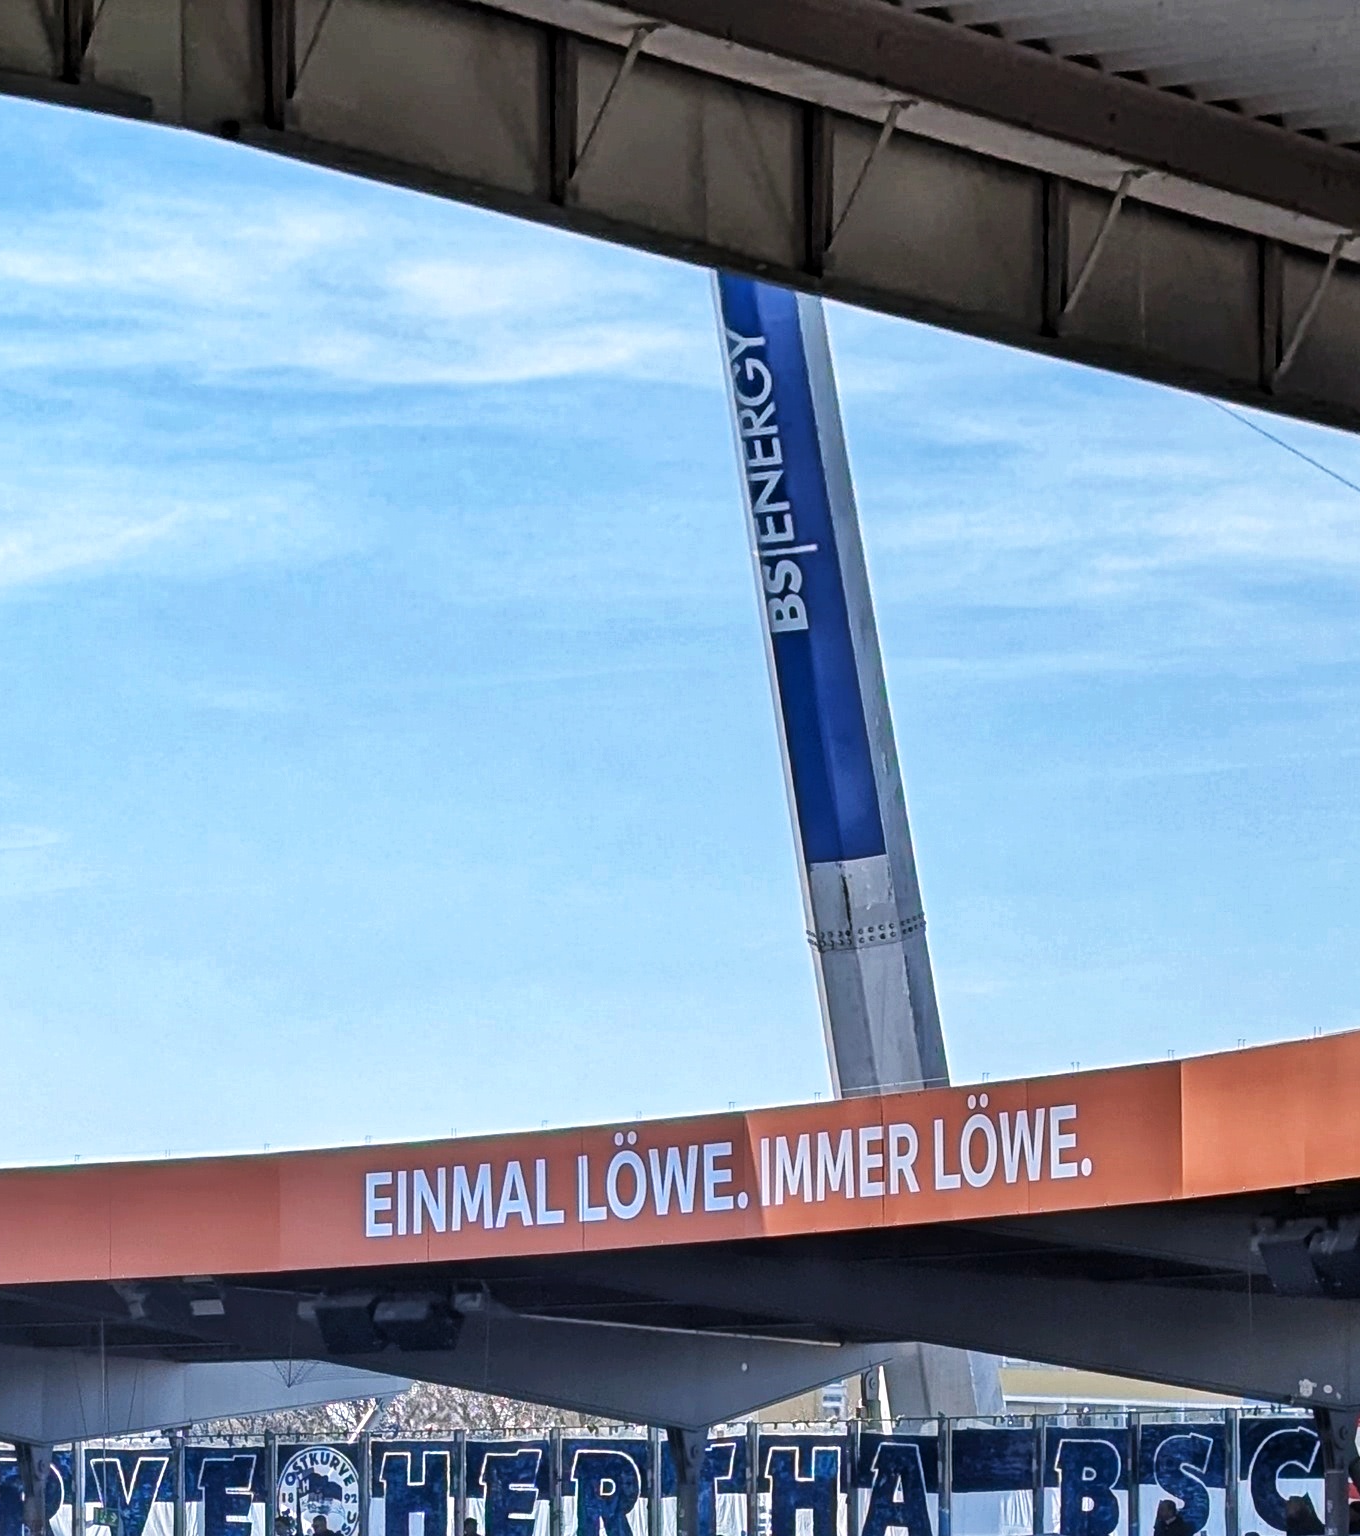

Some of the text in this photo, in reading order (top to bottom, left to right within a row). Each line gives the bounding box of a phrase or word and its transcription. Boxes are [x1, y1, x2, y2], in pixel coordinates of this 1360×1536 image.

[365, 1092, 1093, 1238] EINMAL LÖWE. IMMER LÖWE.
[285, 1451, 356, 1487] OSTKURVE
